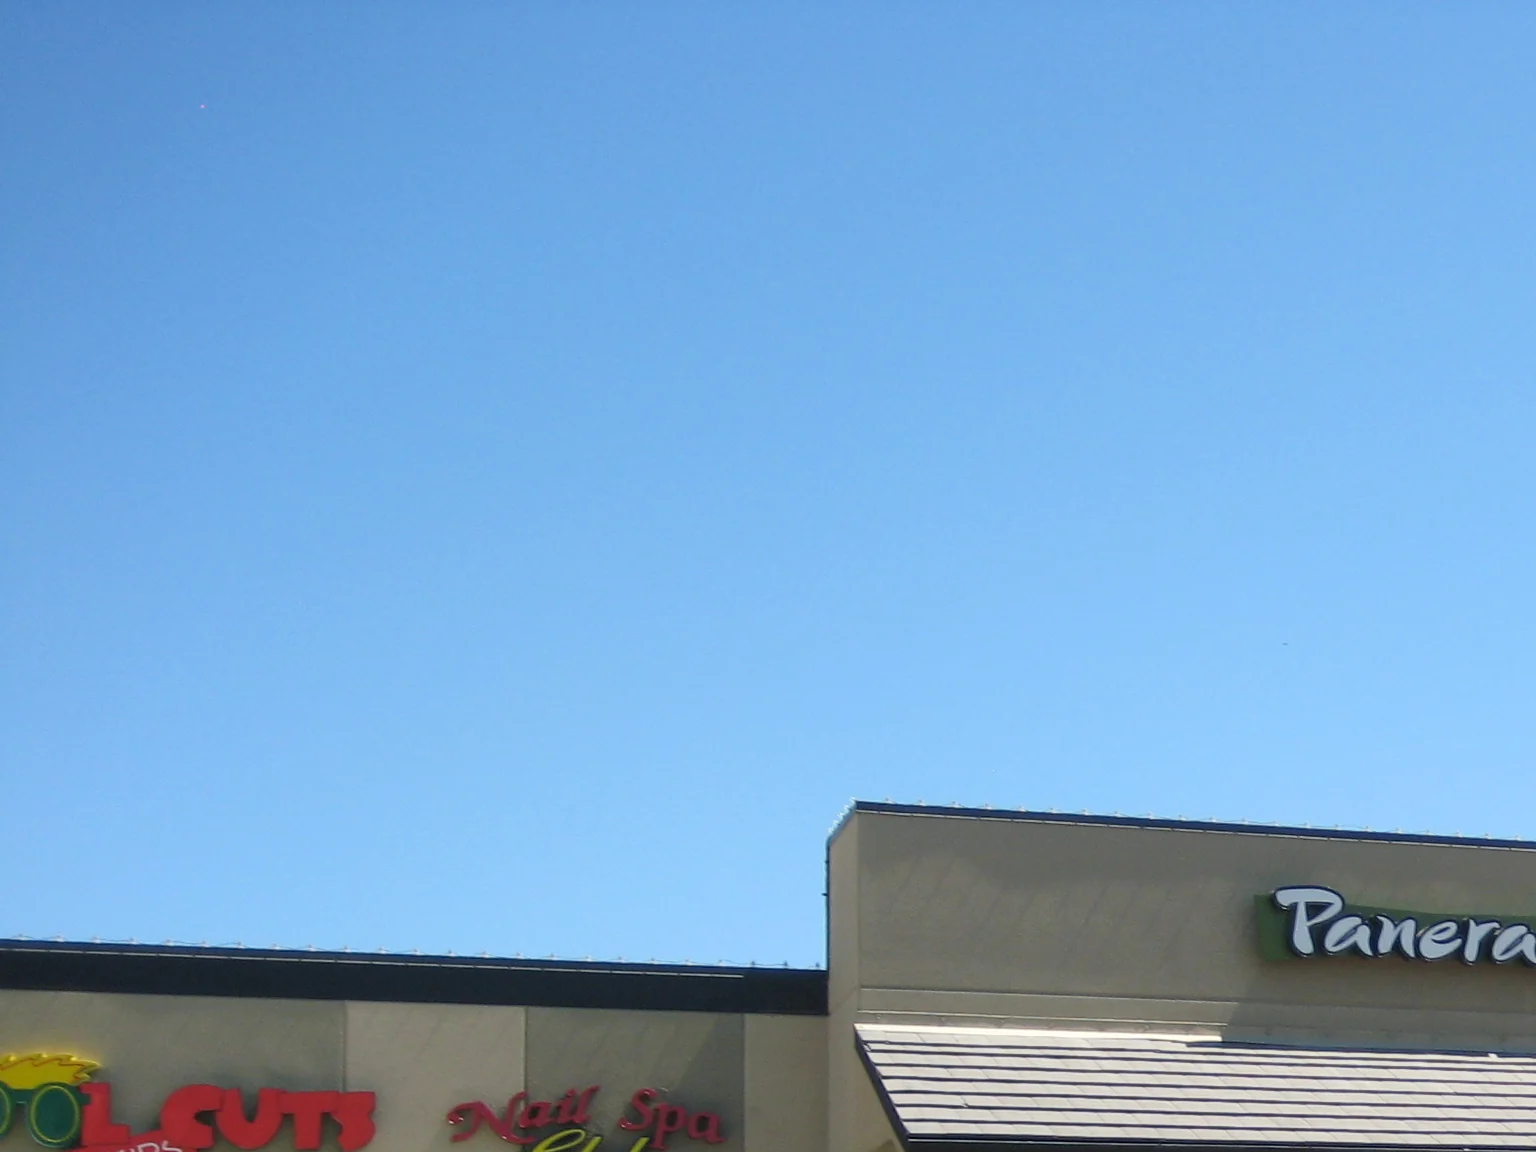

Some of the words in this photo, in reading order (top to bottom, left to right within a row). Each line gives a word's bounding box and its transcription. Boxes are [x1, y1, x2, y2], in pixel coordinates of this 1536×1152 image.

[161, 1084, 376, 1152] CUTS
[446, 1085, 600, 1144] Nail
[617, 1087, 727, 1151] Spa
